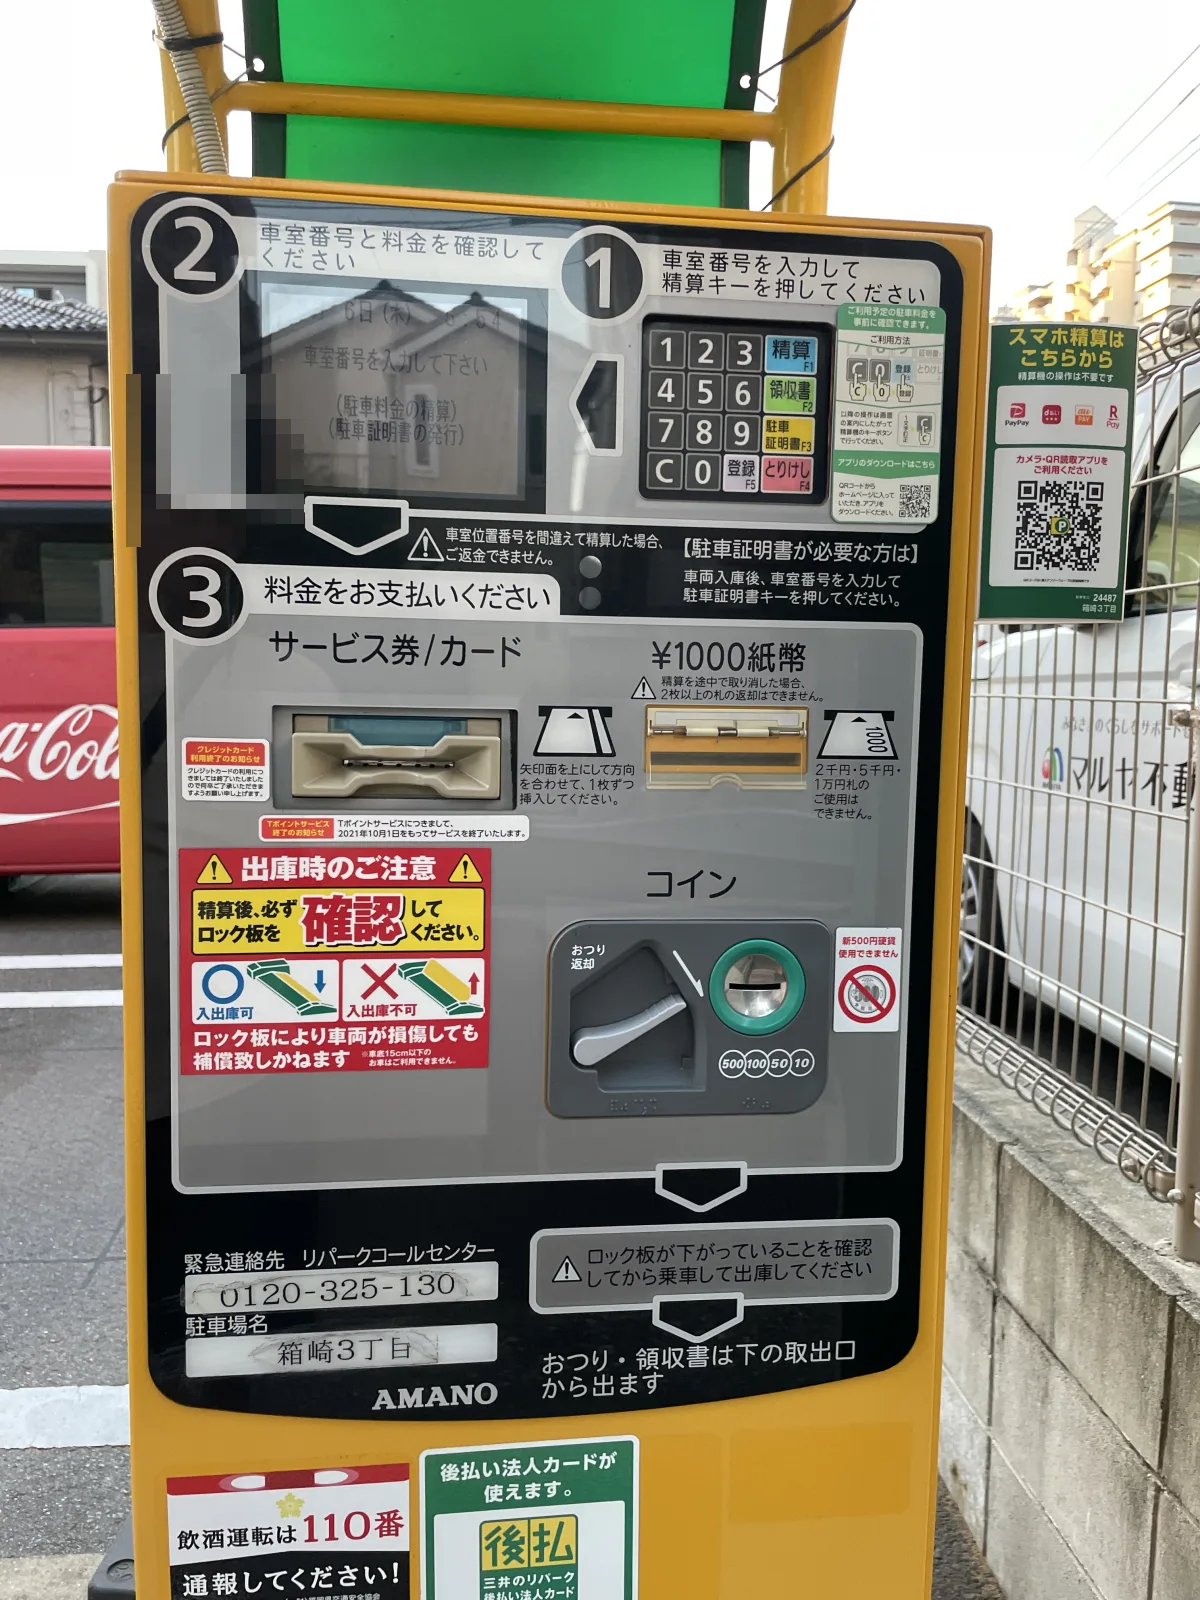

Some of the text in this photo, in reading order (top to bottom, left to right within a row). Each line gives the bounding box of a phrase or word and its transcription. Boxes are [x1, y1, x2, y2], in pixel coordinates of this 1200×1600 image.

[174, 215, 216, 283] 2
[260, 222, 544, 263] 車室番号と料金を確認して
[262, 247, 356, 272] ください
[662, 248, 861, 281] 車室番号を入力して
[583, 246, 611, 309] 1
[661, 273, 926, 305] 精算キーを押してください
[847, 306, 937, 319] ご利用予定の駐車料金を
[853, 317, 930, 330] 事前に確認できます。
[870, 335, 911, 345] ご利用方法
[1008, 327, 1124, 348] スマホ精算は
[660, 337, 672, 362] 1
[697, 338, 714, 364] 2
[736, 340, 753, 366] 3
[771, 339, 811, 360] 精算
[1020, 348, 1113, 369] こちらから
[304, 345, 488, 377] 車室番号を入力して下さい
[804, 362, 814, 372] F1
[1017, 371, 1115, 383] 精算機の操作は不要です
[657, 377, 676, 403] 4
[697, 379, 714, 405] 5
[735, 380, 751, 406] 6
[770, 379, 811, 401] 領収書
[802, 401, 814, 412] F2
[658, 418, 675, 443] 7
[695, 419, 713, 445] 8
[766, 420, 790, 433] 駐車
[1004, 419, 1030, 428] PayPay
[1106, 420, 1120, 430] Pay
[733, 421, 750, 446] 9
[765, 436, 801, 451] 証明書
[801, 441, 812, 452] F3
[727, 459, 756, 477] 登録
[837, 458, 936, 470] アプリのダウンロードはこちら
[1016, 454, 1108, 466] カメラ・QR読取アプリを
[655, 458, 674, 484] C
[694, 459, 712, 485] 0
[765, 461, 810, 479] とりけし
[1033, 465, 1093, 475] ご利用ください
[745, 479, 756, 490] F5
[799, 481, 810, 491] F4
[838, 482, 876, 490] QRコードから
[838, 491, 895, 499] ホームページに入って
[445, 527, 664, 550] 車室位置番号を間違えて精算した場合、
[446, 548, 555, 567] ご返金できません。
[683, 537, 919, 565] 【駐車証明書が必要な方は】
[683, 570, 902, 589] 車両入庫後、車室番号を入力して
[181, 565, 223, 629] 3
[263, 575, 551, 610] 料金をお支払いください
[682, 588, 901, 608] 駐車証明書キーを押してください。
[1093, 593, 1118, 603] 24487
[1081, 603, 1117, 614] 箱崎3丁目
[268, 631, 523, 668] サービス券/カード
[651, 640, 808, 673] ¥1000紙幣
[661, 675, 806, 690] 精算を途中で取り消した場合、
[660, 688, 825, 703] 2枚以上の札の返却はできません。
[0, 703, 119, 781] a-Col
[865, 726, 888, 753] 1000
[190, 754, 261, 764] 利用終了のお知らせ
[197, 745, 255, 755] クレジットカード
[187, 767, 265, 776] クレジットカードの利用につ
[187, 775, 265, 783] きましては終了いたしました
[519, 762, 636, 777] 矢印面を上にして方向
[187, 782, 265, 791] ので何卒ご了承いただきま
[519, 777, 635, 791] を合わせて、1枚ずつ
[814, 778, 870, 791] 1万円札の
[187, 790, 264, 798] すようお願い申し上げます。
[519, 792, 619, 806] 挿入してください。
[814, 793, 860, 806] ご使用は
[814, 807, 873, 820] できません。
[267, 819, 330, 828] Tポイントサービス
[272, 827, 326, 837] 終了のお知らせ
[338, 819, 454, 829] Tポイントサービスにつきまして、
[337, 828, 527, 839] 2021年10月1日をもってサービスを終了いたします。
[241, 854, 437, 883] 出庫時のご注意
[646, 869, 737, 900] コイン
[197, 891, 444, 947] 精算後、必ず 確認 して
[198, 923, 480, 945] ロック板を ください。
[841, 936, 897, 946] 新500円硬貨
[571, 943, 606, 956] おつり
[838, 949, 899, 959] 使用できません
[570, 957, 596, 970] 返却
[196, 1006, 254, 1021] 入出庫可
[346, 1003, 418, 1018] 入出庫不可
[193, 1023, 480, 1048] ロック板により車両が損傷しても
[193, 1049, 351, 1071] 補償致しかねます
[368, 1056, 457, 1068] お車はご利用できません。
[722, 1057, 810, 1069] 500 100 50 10
[185, 1241, 495, 1275] 緊急連絡先 リパークコールセンター
[587, 1237, 873, 1265] ロック板が下がっていることを確認
[587, 1260, 873, 1289] してから乗車して出庫してください
[219, 1273, 456, 1309] 0120-325-130
[185, 1315, 269, 1337] 駐車場名
[277, 1336, 412, 1367] 箱崎3丁目
[541, 1340, 857, 1376] おつり・領収書は下の取出口
[540, 1371, 665, 1401] から出ます
[371, 1382, 498, 1411] AMANO
[439, 1450, 619, 1483] 後払い法人カードが
[483, 1480, 580, 1504] 使えます。
[484, 1521, 575, 1568] 後払
[182, 1561, 400, 1598] 通報してください!
[483, 1571, 575, 1590] 三井のリパーク
